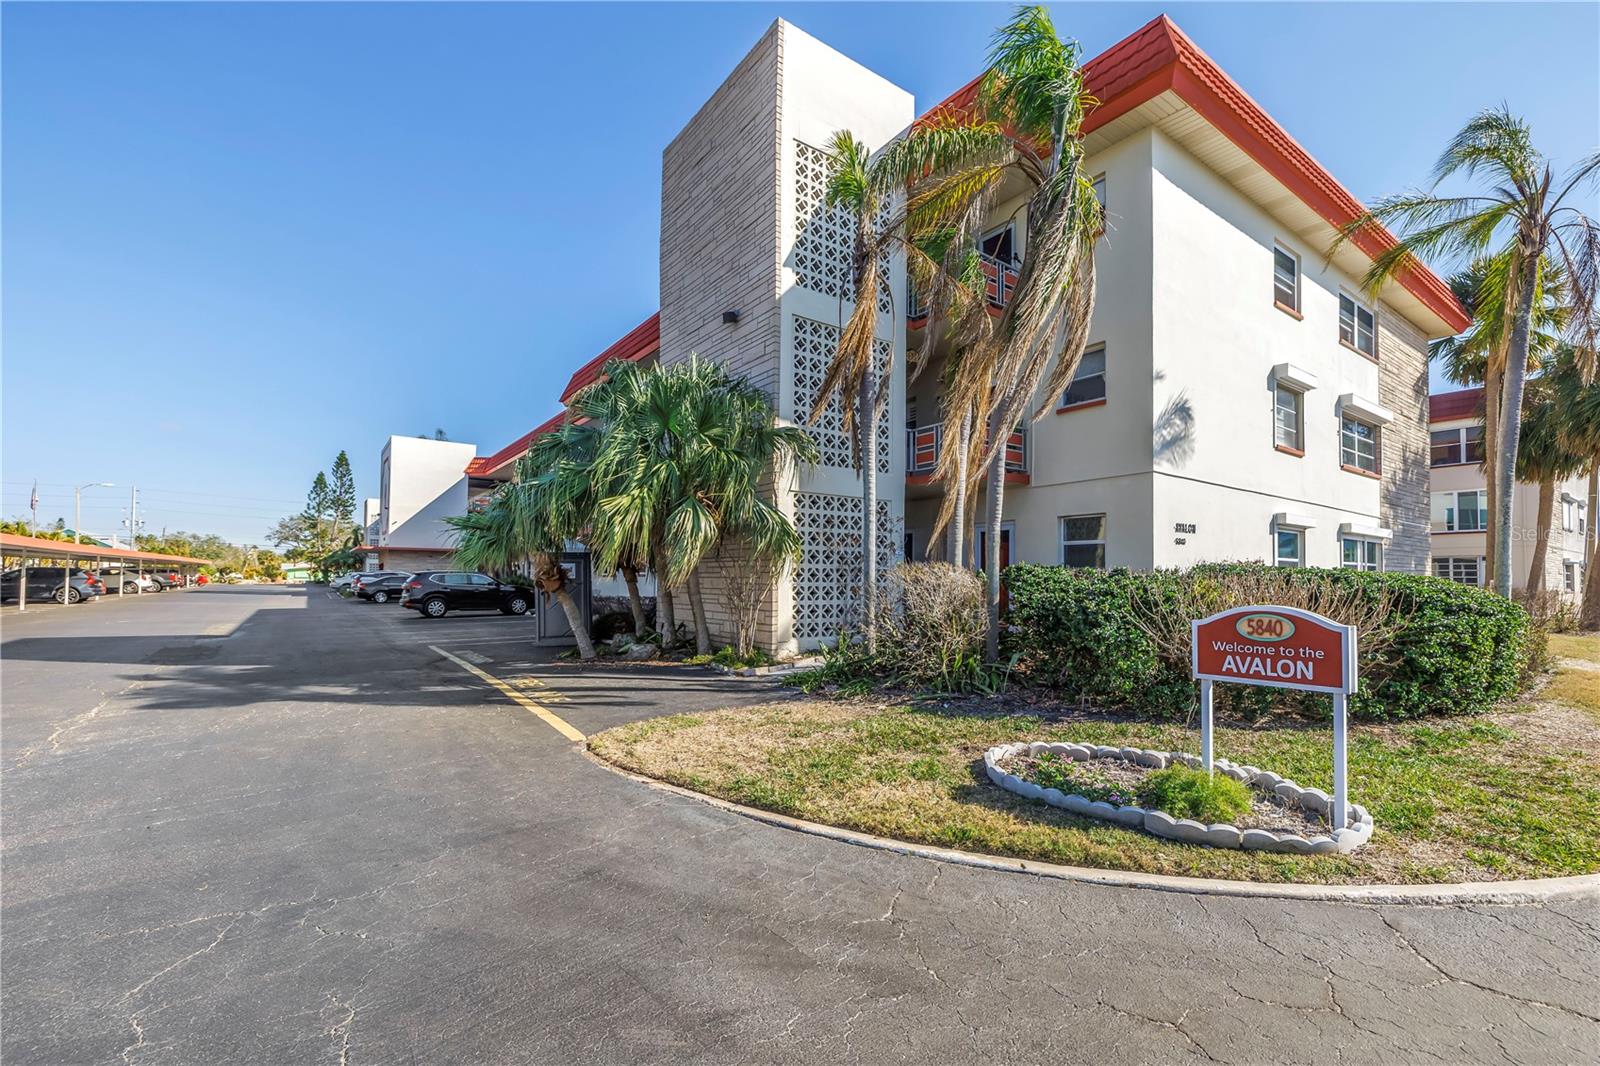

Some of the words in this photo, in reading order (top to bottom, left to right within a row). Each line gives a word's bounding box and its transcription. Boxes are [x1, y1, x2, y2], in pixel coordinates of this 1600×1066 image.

[1246, 619, 1284, 637] 5840
[1212, 641, 1276, 656] Welcome
[1279, 646, 1295, 657] to
[1299, 647, 1325, 659] the
[1221, 655, 1314, 681] AVALON
